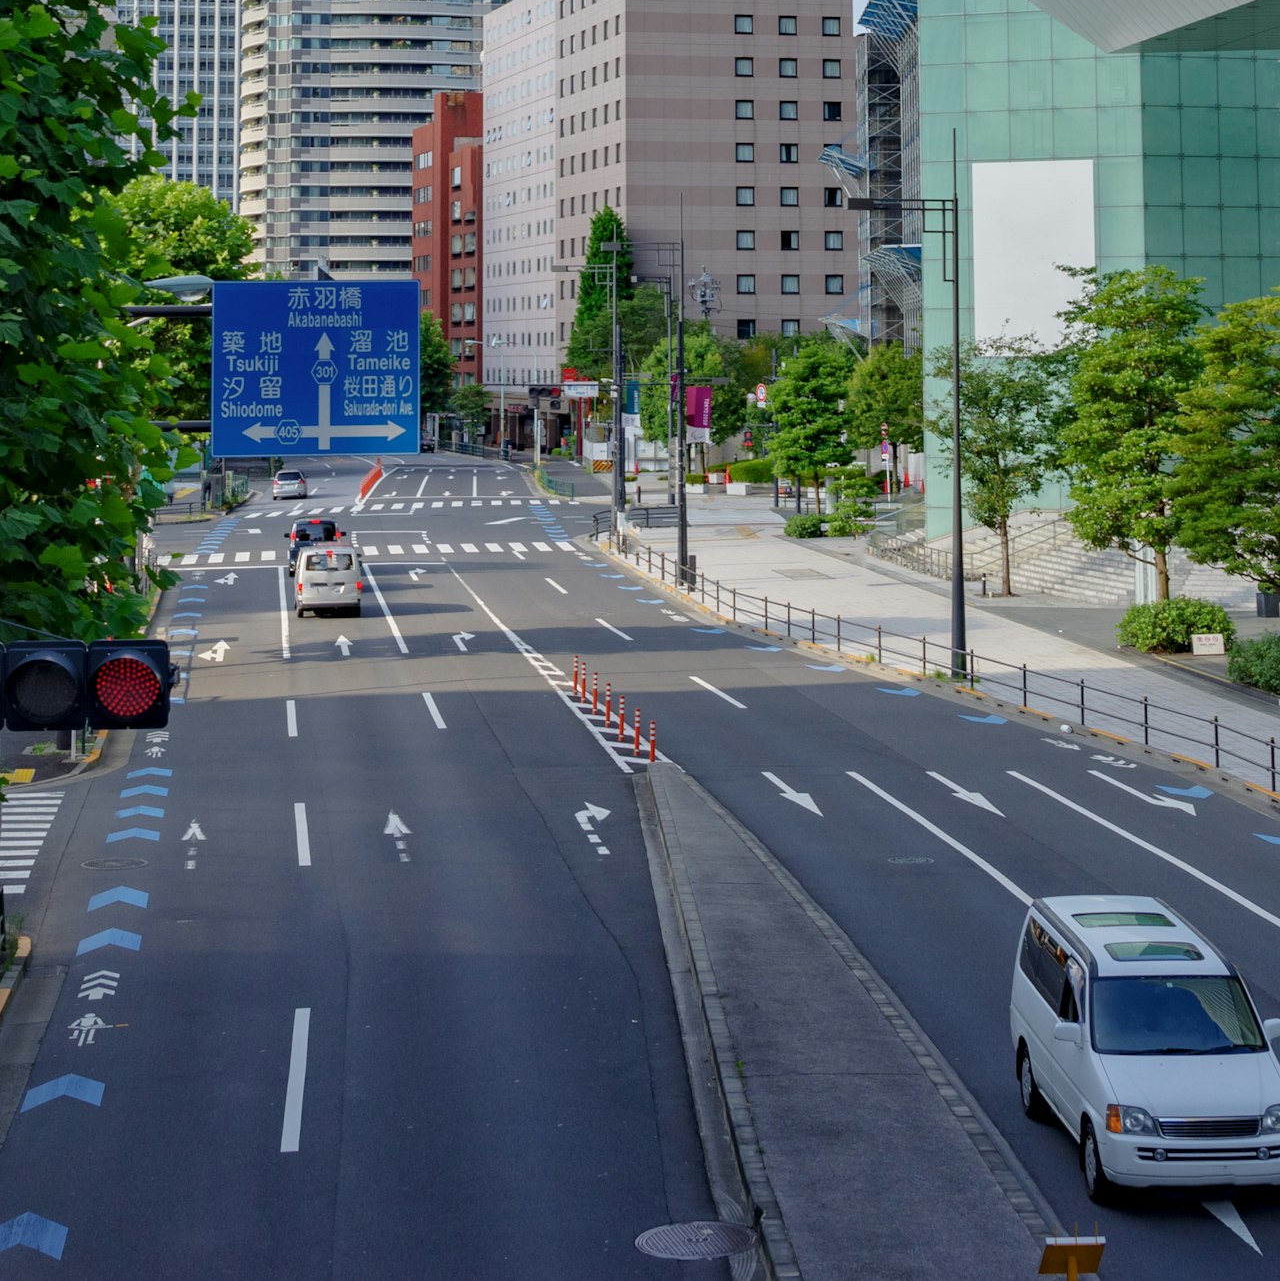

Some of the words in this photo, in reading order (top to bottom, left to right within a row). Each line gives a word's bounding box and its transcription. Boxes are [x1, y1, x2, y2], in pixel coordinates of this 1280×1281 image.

[288, 287, 362, 309] 赤羽橋
[288, 312, 362, 328] Akabanebashi
[222, 331, 282, 354] 築地
[350, 330, 409, 353] 溜池
[226, 356, 279, 375] Tsukiji
[348, 355, 411, 370] Tameike
[316, 366, 334, 378] 301
[222, 377, 282, 400] 汐留
[344, 375, 413, 398] 桜田通り
[221, 401, 283, 418] Shiodome
[344, 400, 398, 416] Sakurada-dori
[399, 400, 415, 416] Ave.
[279, 427, 299, 439] 405
